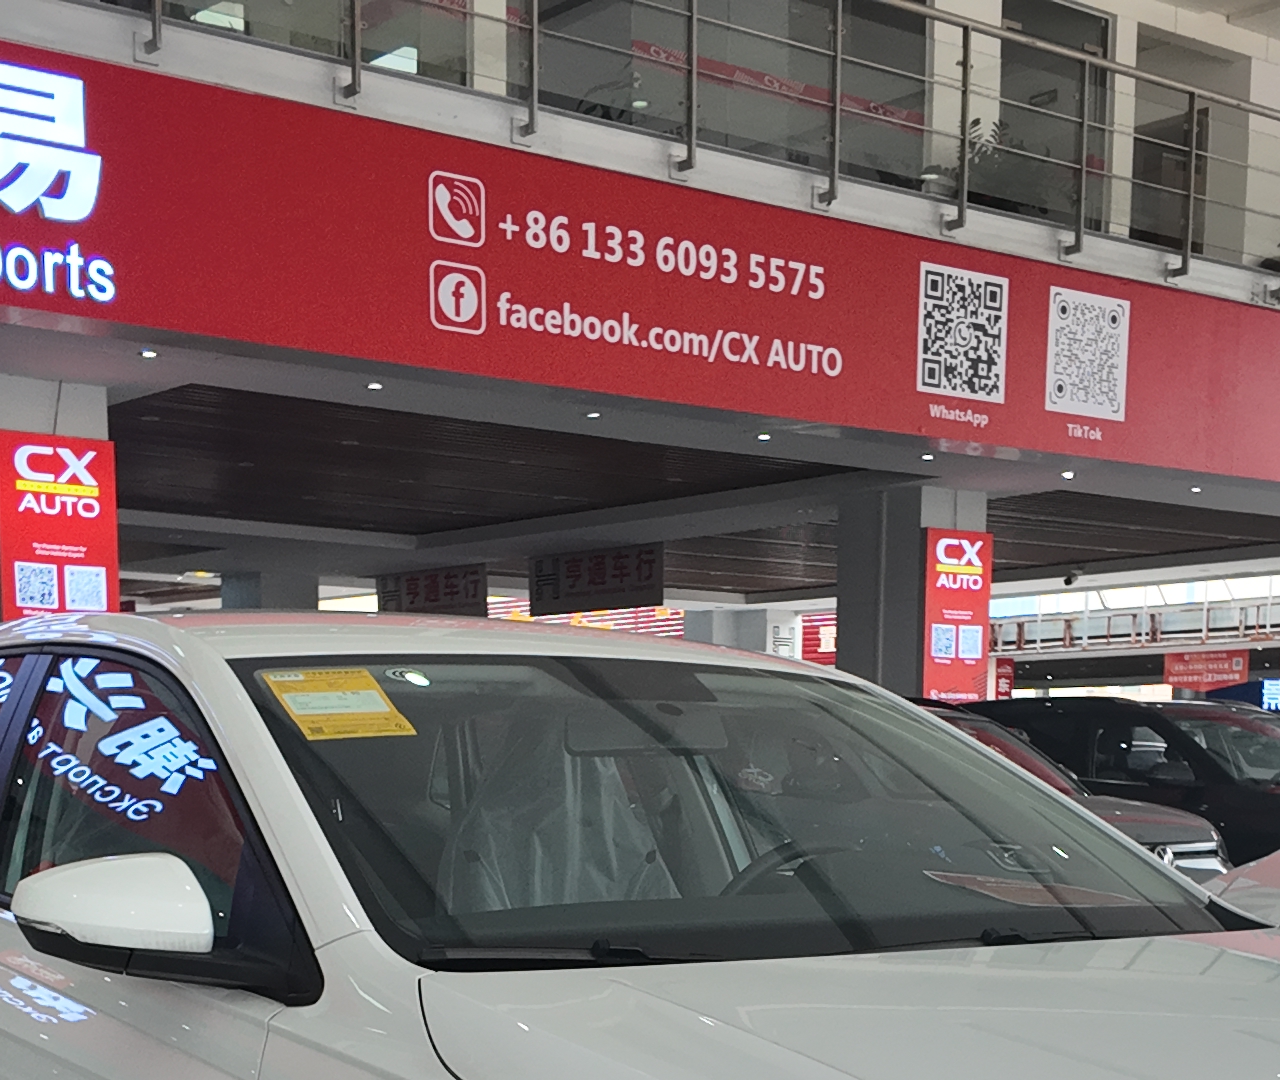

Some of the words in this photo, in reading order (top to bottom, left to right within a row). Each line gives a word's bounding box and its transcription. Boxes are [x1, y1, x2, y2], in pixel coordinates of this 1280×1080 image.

[498, 210, 571, 254] +86
[581, 222, 646, 268] 133
[655, 236, 738, 284] 6093
[748, 253, 825, 300] 5575
[496, 291, 760, 366] facebook.com/CX
[766, 338, 843, 377] AUTO
[928, 403, 990, 429] WhatsApp
[1066, 423, 1103, 442] TikTok
[13, 444, 99, 487] CX
[17, 493, 101, 519] AUTO
[935, 537, 984, 567] CX
[564, 548, 656, 590] 亨通车行
[935, 573, 983, 591] AUTO
